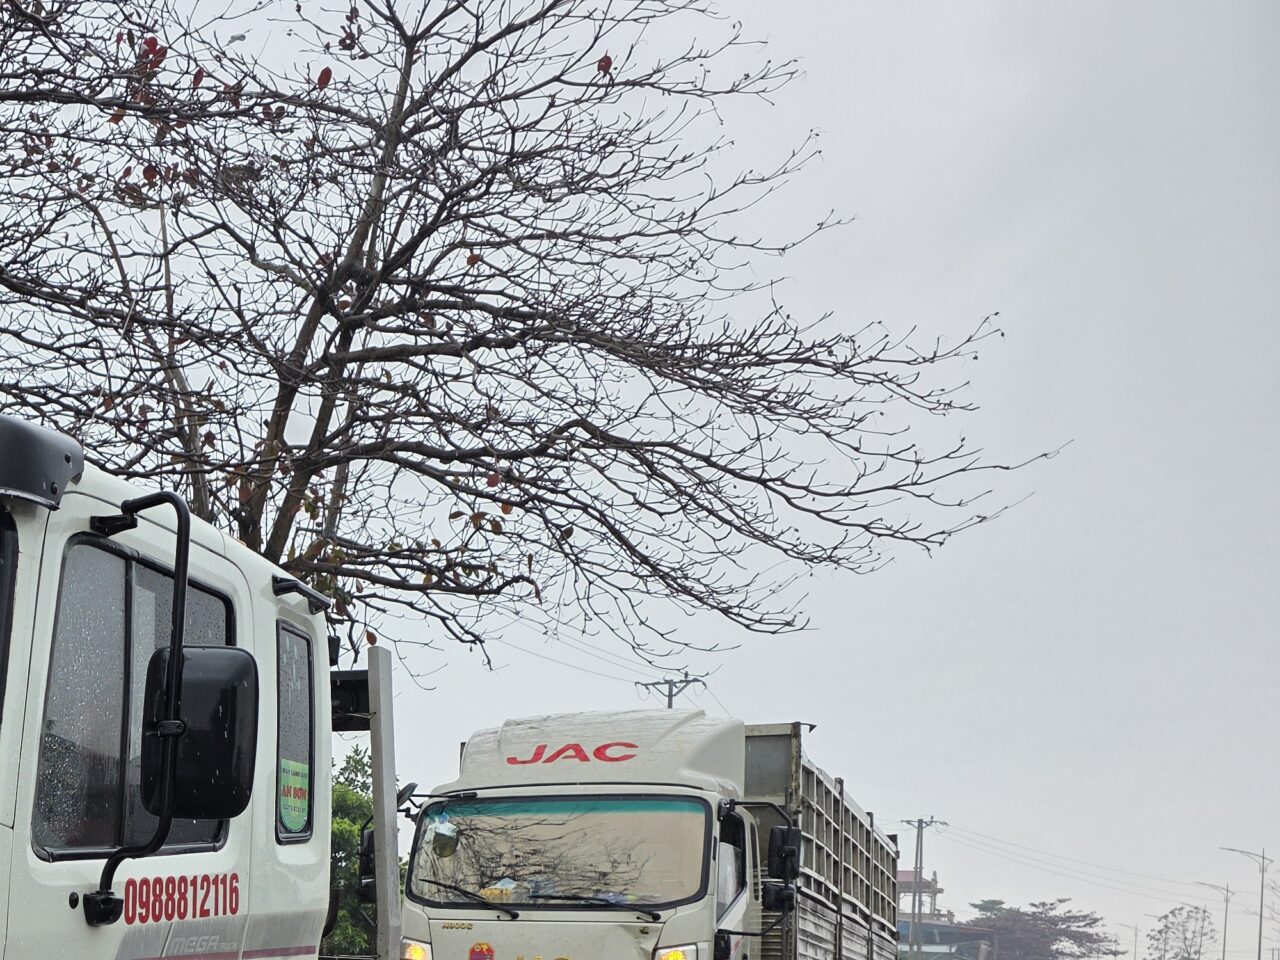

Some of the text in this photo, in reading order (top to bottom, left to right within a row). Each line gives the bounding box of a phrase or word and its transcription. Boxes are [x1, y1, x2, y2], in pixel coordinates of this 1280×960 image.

[506, 741, 640, 766] JAC
[123, 872, 240, 926] 0988812116
[167, 935, 220, 955] MEGA
